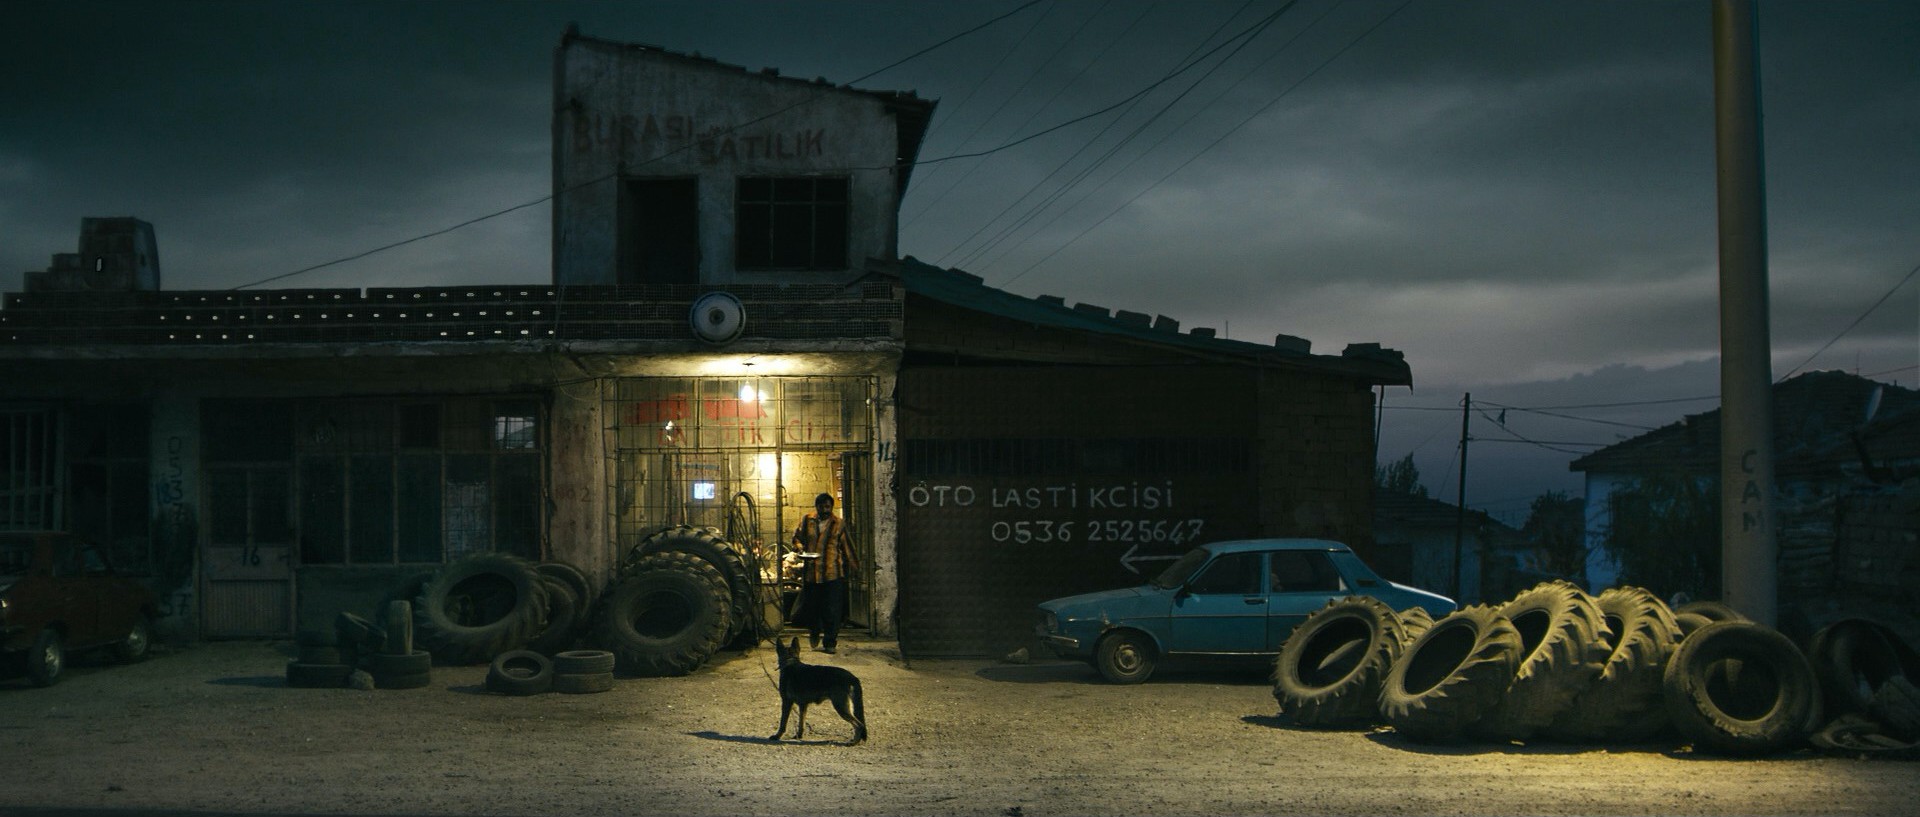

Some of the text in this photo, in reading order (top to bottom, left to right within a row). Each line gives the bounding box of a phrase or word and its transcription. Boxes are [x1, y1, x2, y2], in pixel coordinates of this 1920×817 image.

[574, 112, 693, 152] BURASI
[698, 128, 825, 163] SATILIK
[991, 519, 1204, 544] 0536 2525647
[242, 546, 260, 566] 16
